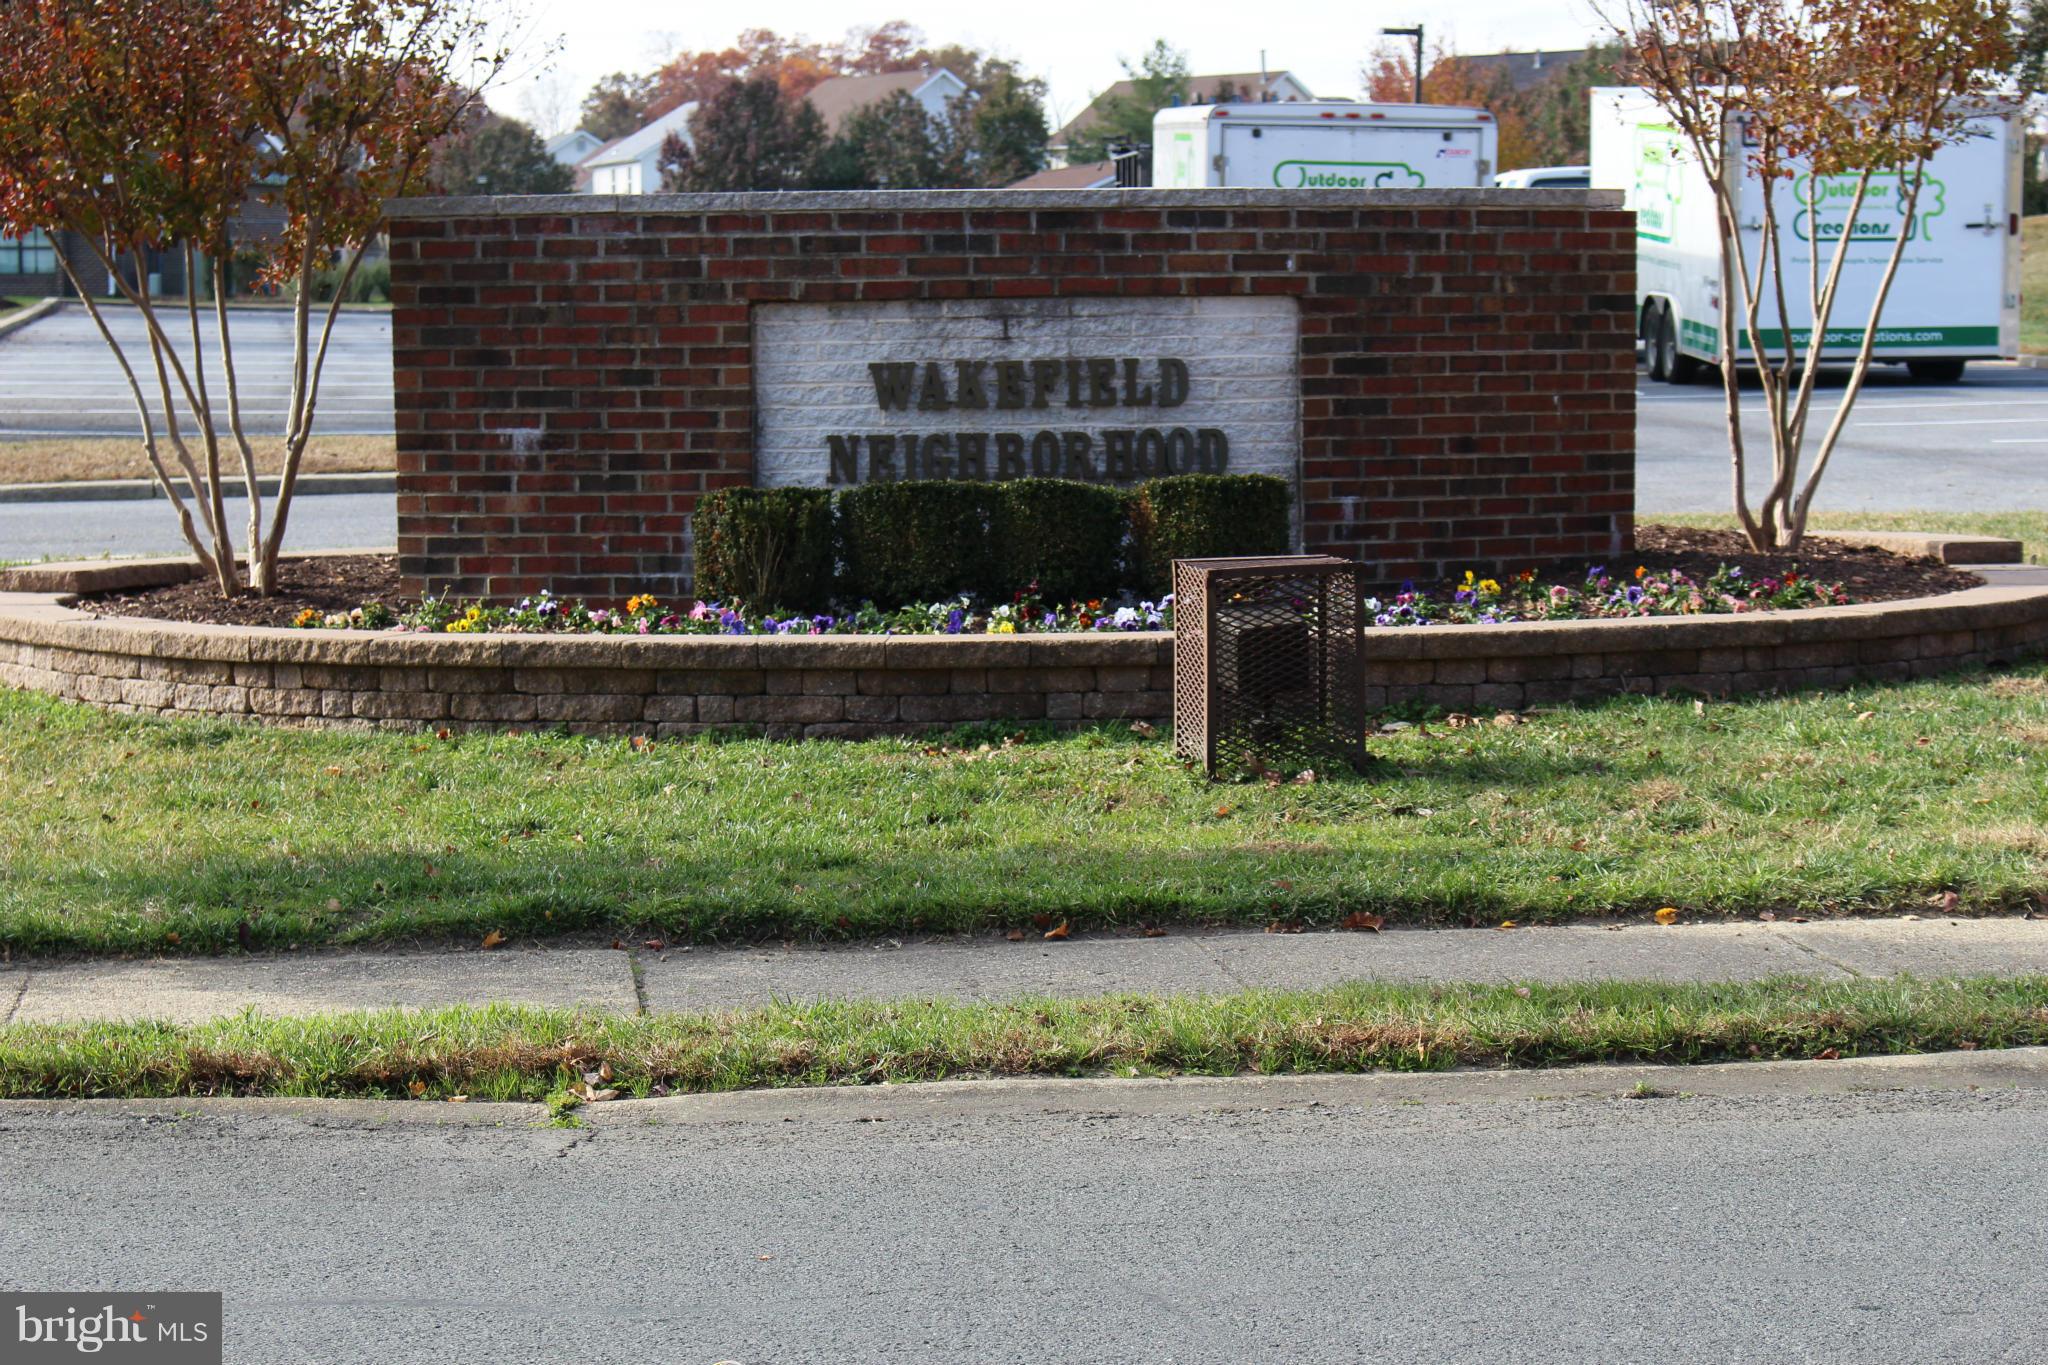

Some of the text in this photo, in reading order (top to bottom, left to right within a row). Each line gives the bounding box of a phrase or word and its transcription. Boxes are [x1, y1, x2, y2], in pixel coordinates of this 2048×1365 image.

[1793, 208, 1890, 241] Creaions
[868, 358, 1190, 411] WAKEFIELD
[826, 428, 1229, 483] NEIGHBORHOOD
